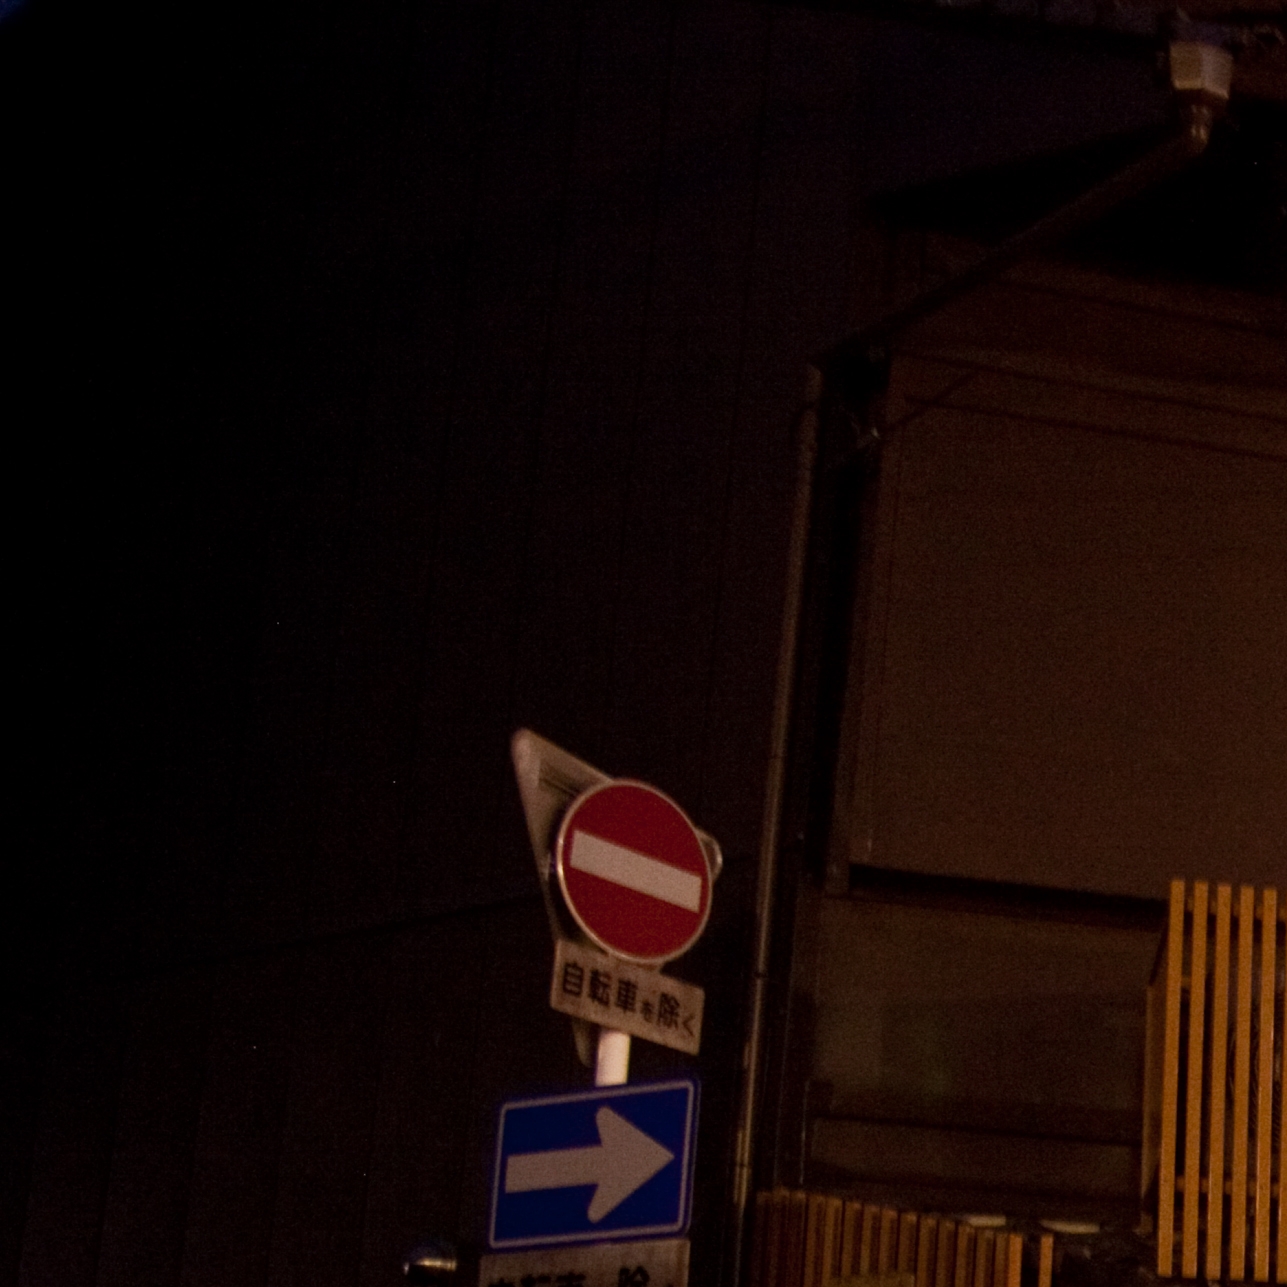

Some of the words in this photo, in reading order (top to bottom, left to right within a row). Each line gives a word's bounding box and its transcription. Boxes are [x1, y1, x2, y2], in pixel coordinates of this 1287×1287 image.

[562, 960, 696, 1038] 自転車を除く
